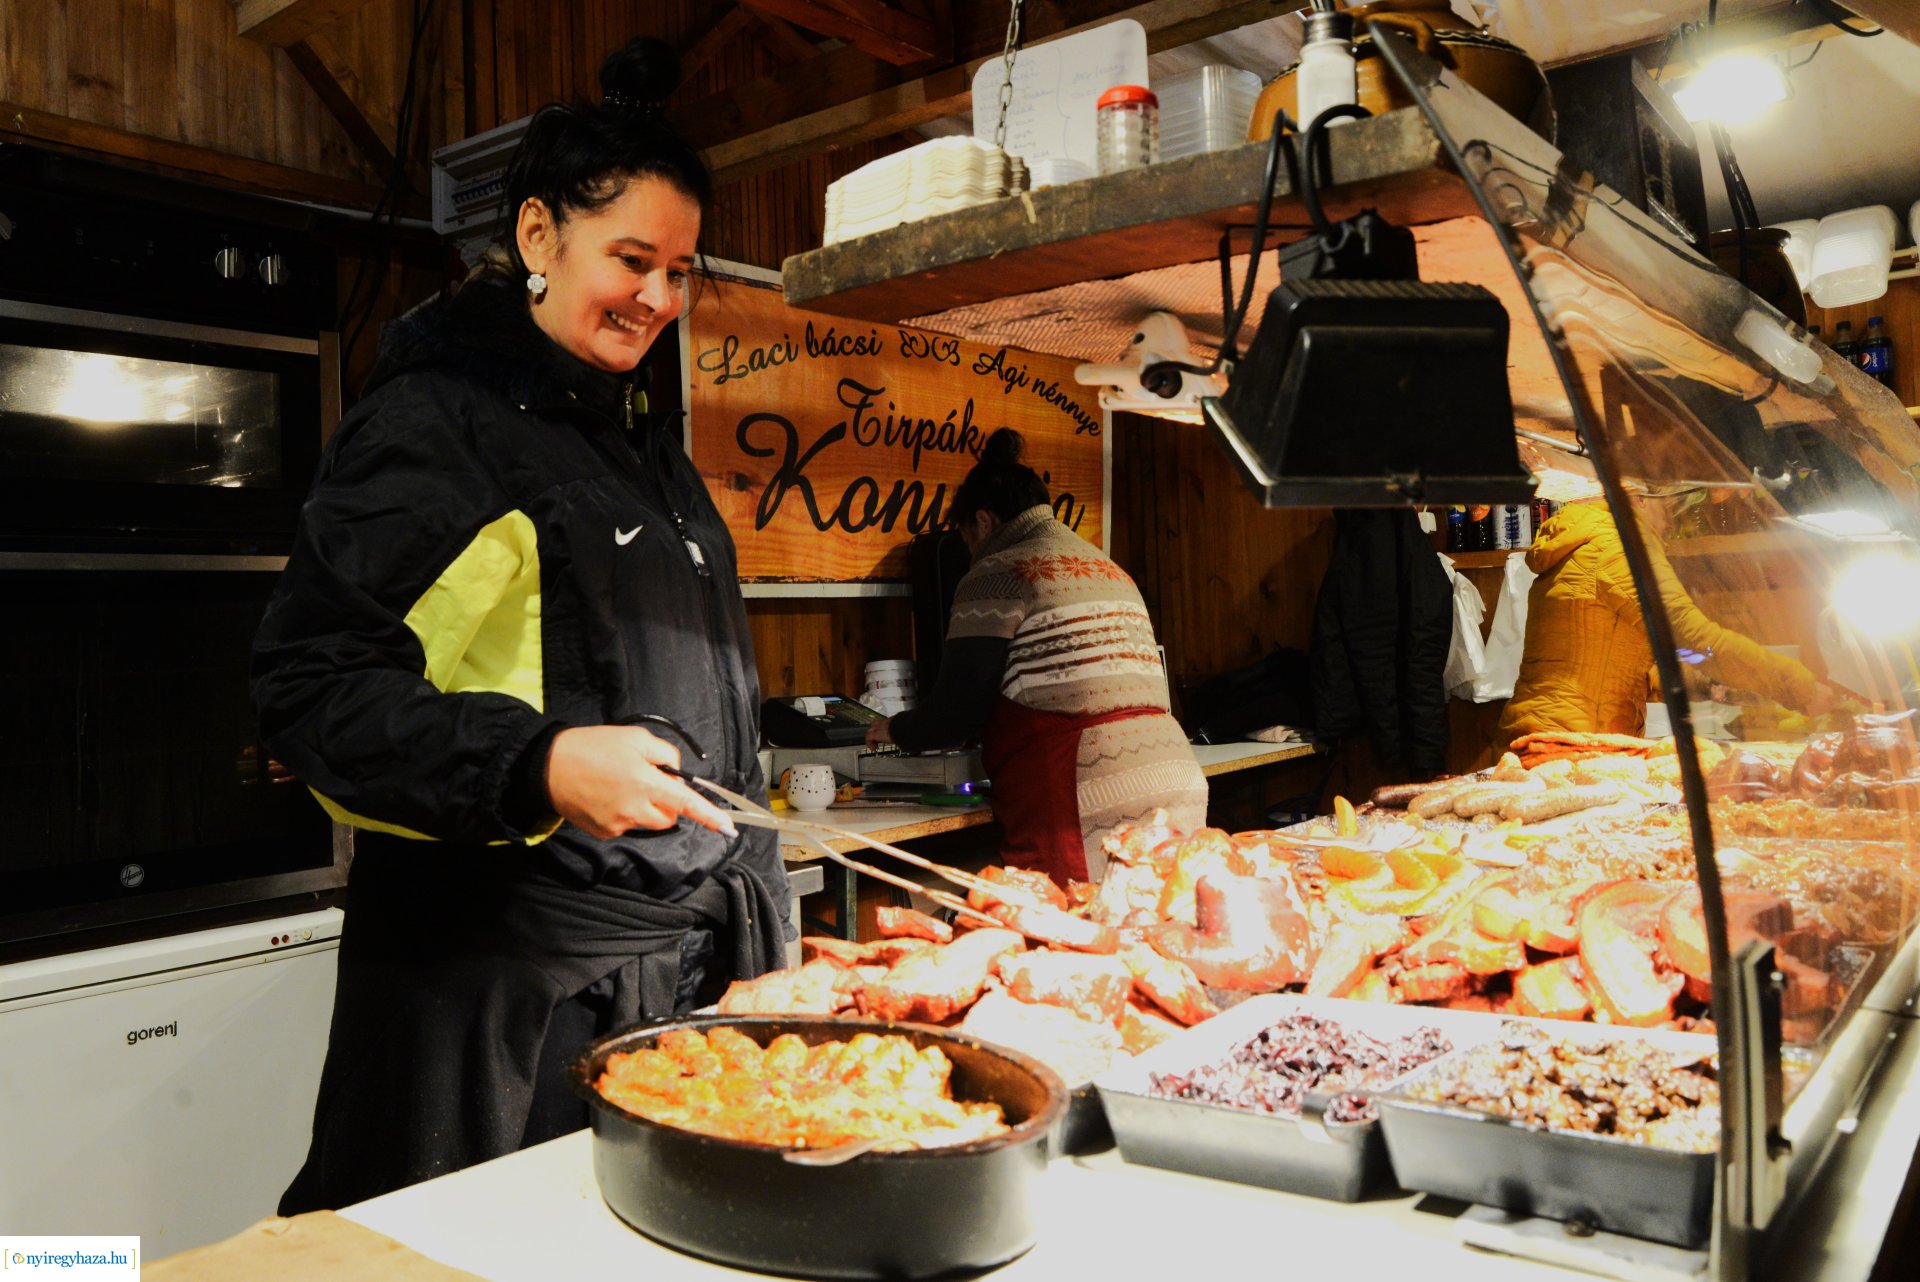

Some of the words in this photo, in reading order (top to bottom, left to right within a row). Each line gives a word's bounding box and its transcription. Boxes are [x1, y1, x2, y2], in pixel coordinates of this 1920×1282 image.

[697, 332, 799, 385] Laci
[805, 320, 883, 358] bácsi
[972, 348, 1030, 394] Agi
[1031, 377, 1101, 437] nénnye
[126, 1020, 178, 1046] gorenj
